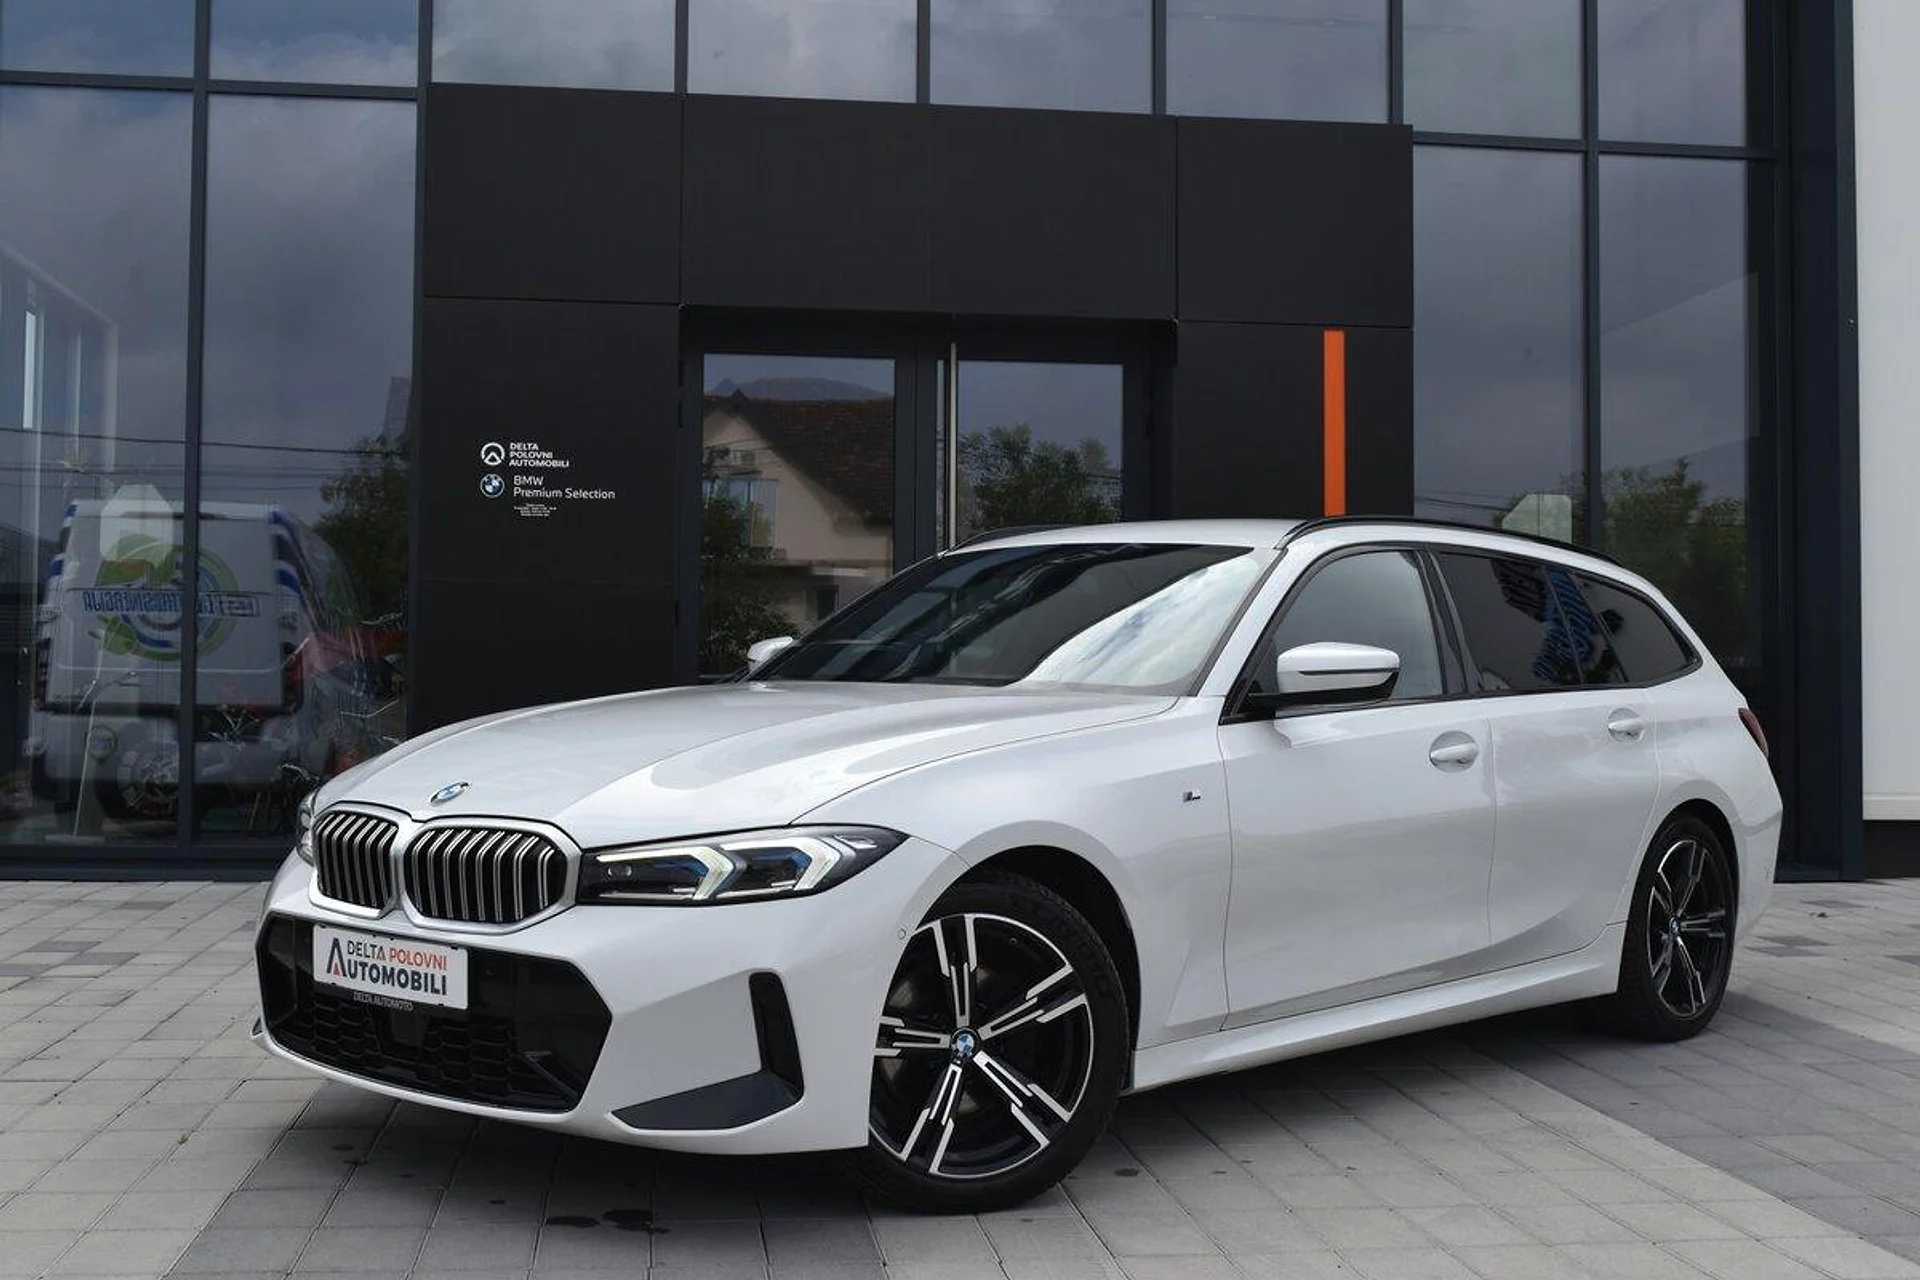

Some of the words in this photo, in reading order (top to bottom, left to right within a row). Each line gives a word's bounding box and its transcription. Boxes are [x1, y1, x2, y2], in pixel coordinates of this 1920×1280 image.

[510, 442, 539, 451] DELTA
[510, 451, 553, 459] POLOVNI
[509, 459, 570, 468] AUTOMOBILI
[513, 475, 544, 486] BMW
[513, 487, 563, 499] Premium
[564, 487, 616, 499] Selection
[347, 940, 387, 961] DELTA
[389, 947, 448, 971] POLOVNI
